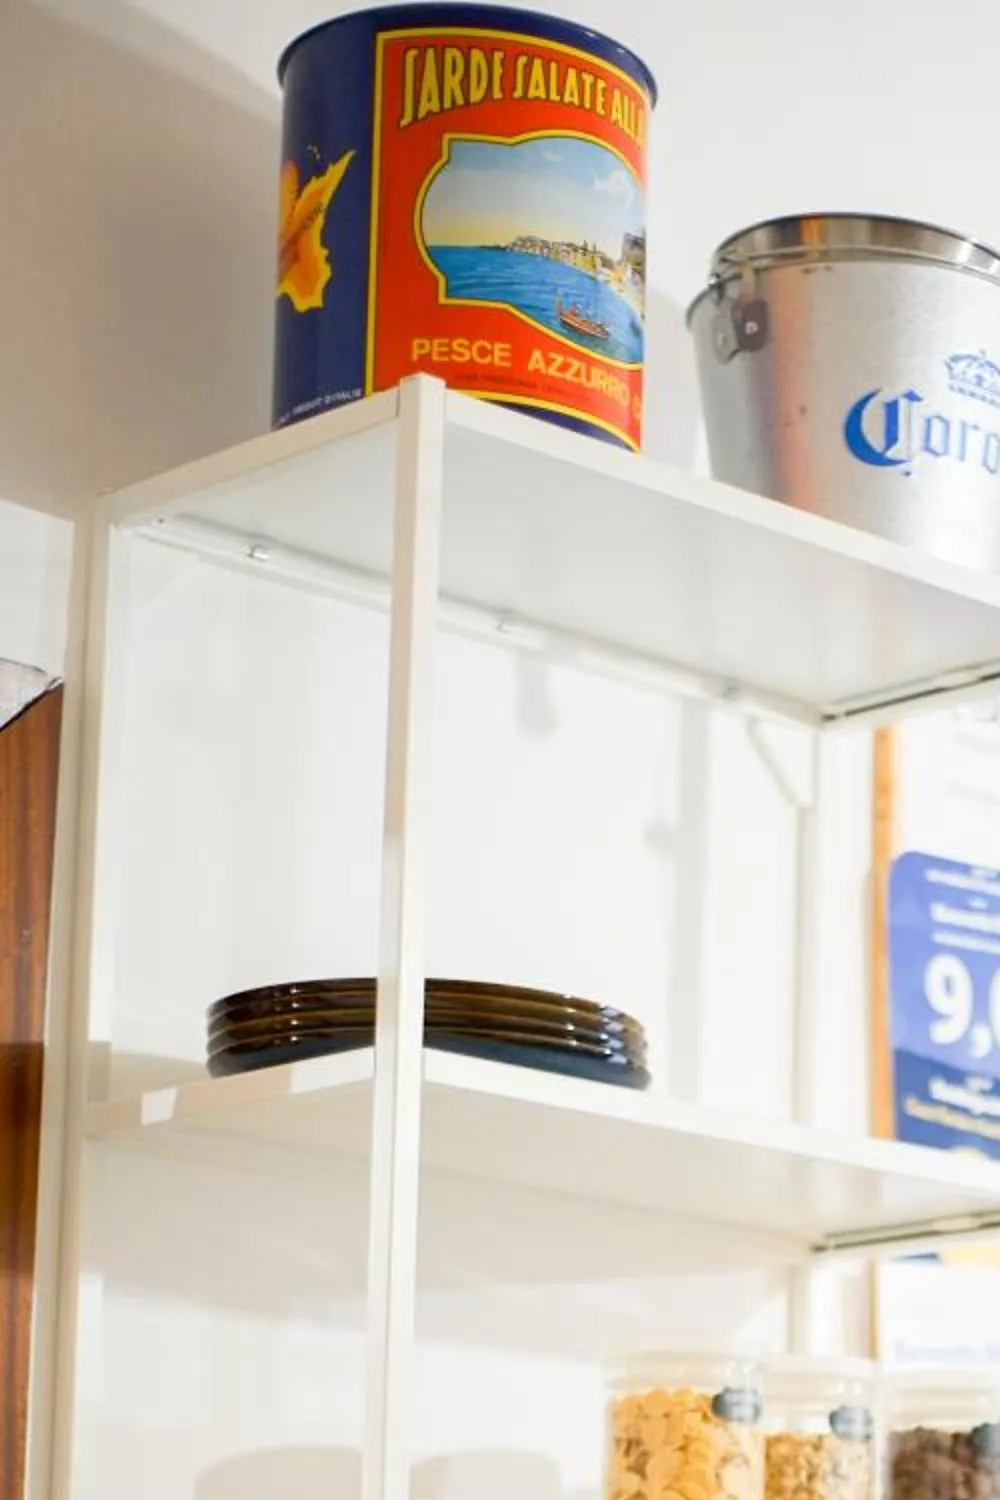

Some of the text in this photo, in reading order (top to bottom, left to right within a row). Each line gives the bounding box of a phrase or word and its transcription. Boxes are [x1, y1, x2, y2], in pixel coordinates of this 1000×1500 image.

[400, 47, 504, 128] SARDE
[513, 55, 607, 115] SALATE
[411, 338, 512, 367] PESCE
[528, 349, 630, 406] AZZURRO
